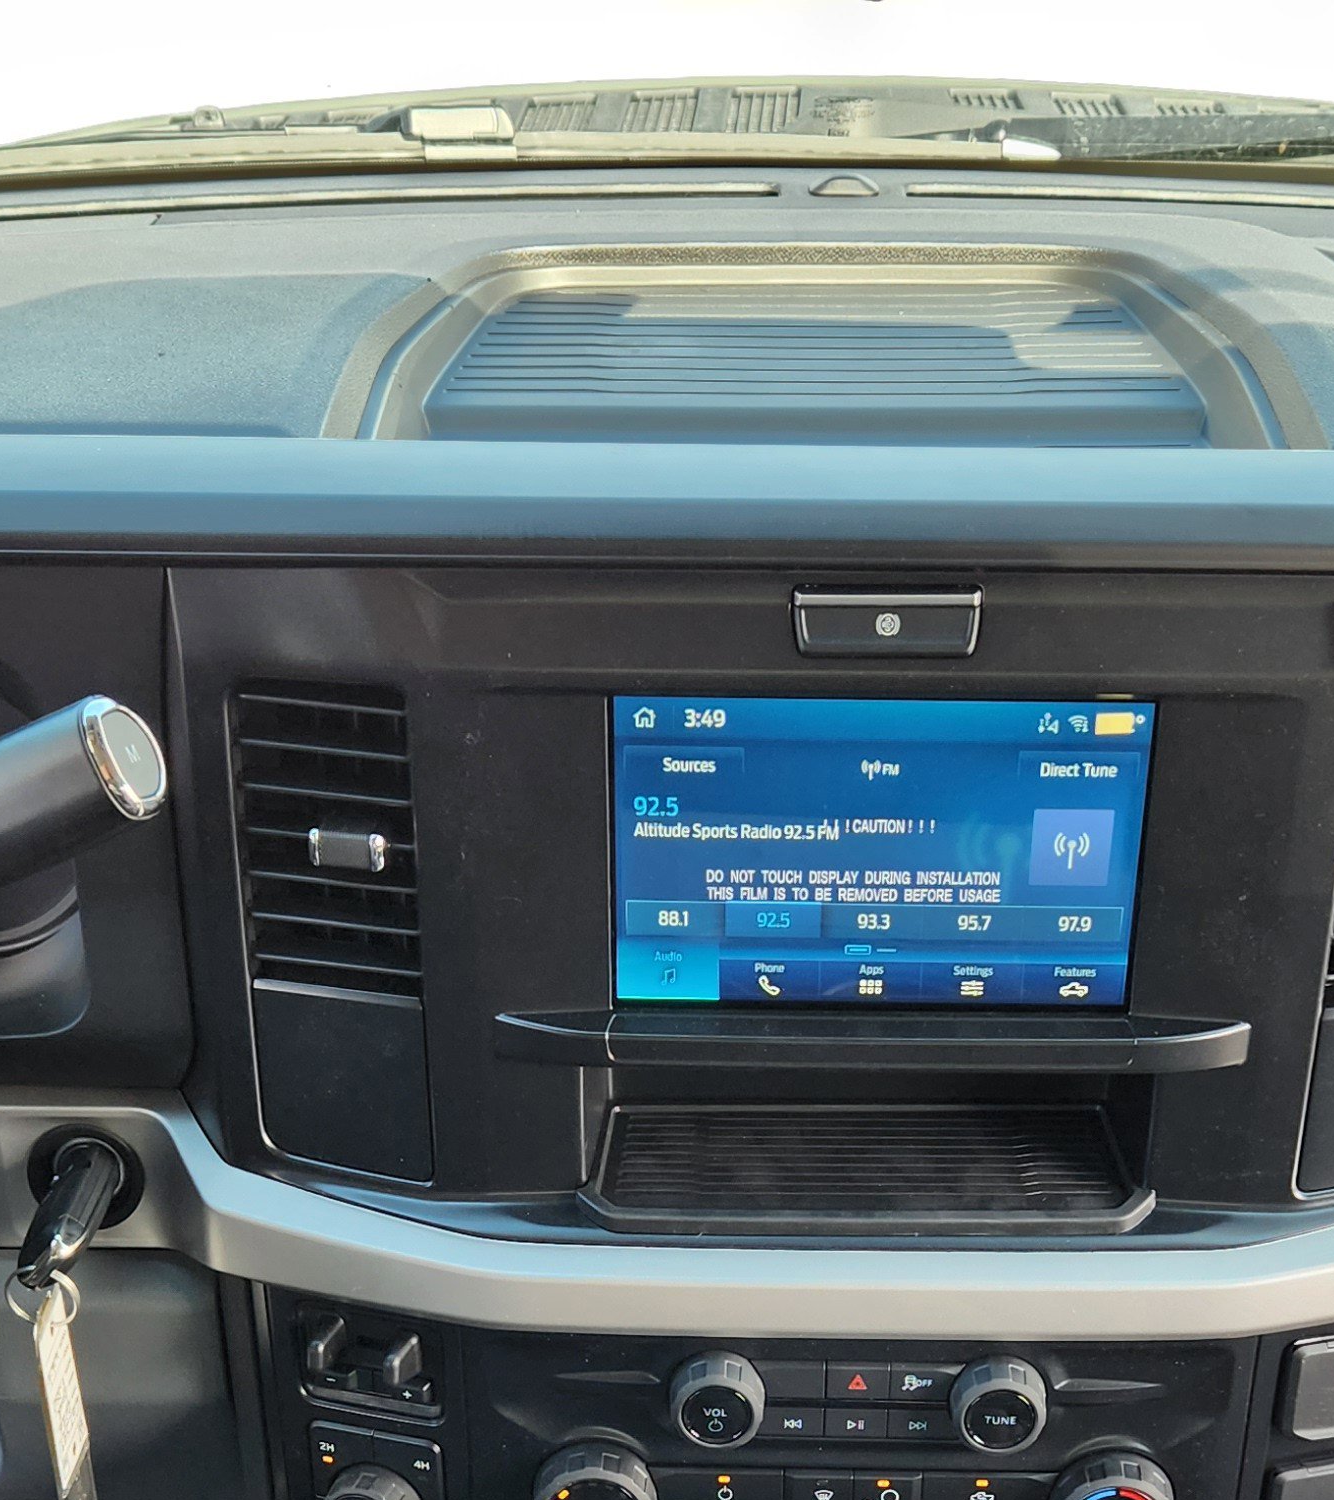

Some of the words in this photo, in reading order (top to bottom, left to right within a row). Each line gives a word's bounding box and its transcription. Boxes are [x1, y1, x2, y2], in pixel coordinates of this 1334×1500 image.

[683, 708, 727, 729] 3:49
[662, 757, 717, 773] Sources
[882, 763, 900, 777] FM
[1039, 762, 1080, 778] Direct
[1082, 762, 1118, 779] Tune
[633, 796, 679, 817] 92.5
[633, 822, 690, 838] Altitude
[692, 823, 738, 842] Sports
[740, 824, 782, 840] Radio
[784, 825, 815, 840] 92.5
[705, 869, 724, 883] DO
[730, 869, 755, 883] NOT
[761, 869, 803, 884] TOUCH
[808, 870, 859, 885] DISPLAY
[864, 871, 911, 885] DURING
[916, 871, 1001, 886] INSTALLATION
[706, 886, 734, 900] THIS
[740, 886, 768, 900] FILM
[773, 887, 786, 900] IS
[792, 887, 809, 900] TO
[814, 887, 832, 901] BE
[838, 888, 898, 902] REMOVED
[904, 888, 953, 902] BEFORE
[959, 888, 1002, 903] USAGE
[658, 910, 689, 927] 88.1
[756, 912, 790, 929] 92.5
[857, 913, 891, 930] 93.3
[957, 915, 992, 931] 95.7
[1058, 916, 1092, 932] 97.9
[654, 951, 683, 962] Audio
[754, 962, 785, 974] Phone
[859, 964, 885, 976] Apps
[953, 966, 994, 978] Settings
[1053, 966, 1097, 978] Features
[916, 1378, 933, 1388] OFF
[702, 1407, 728, 1418] VOL
[984, 1415, 1017, 1426] TUNE
[319, 1441, 335, 1453] 2H
[413, 1459, 430, 1471] 4H
